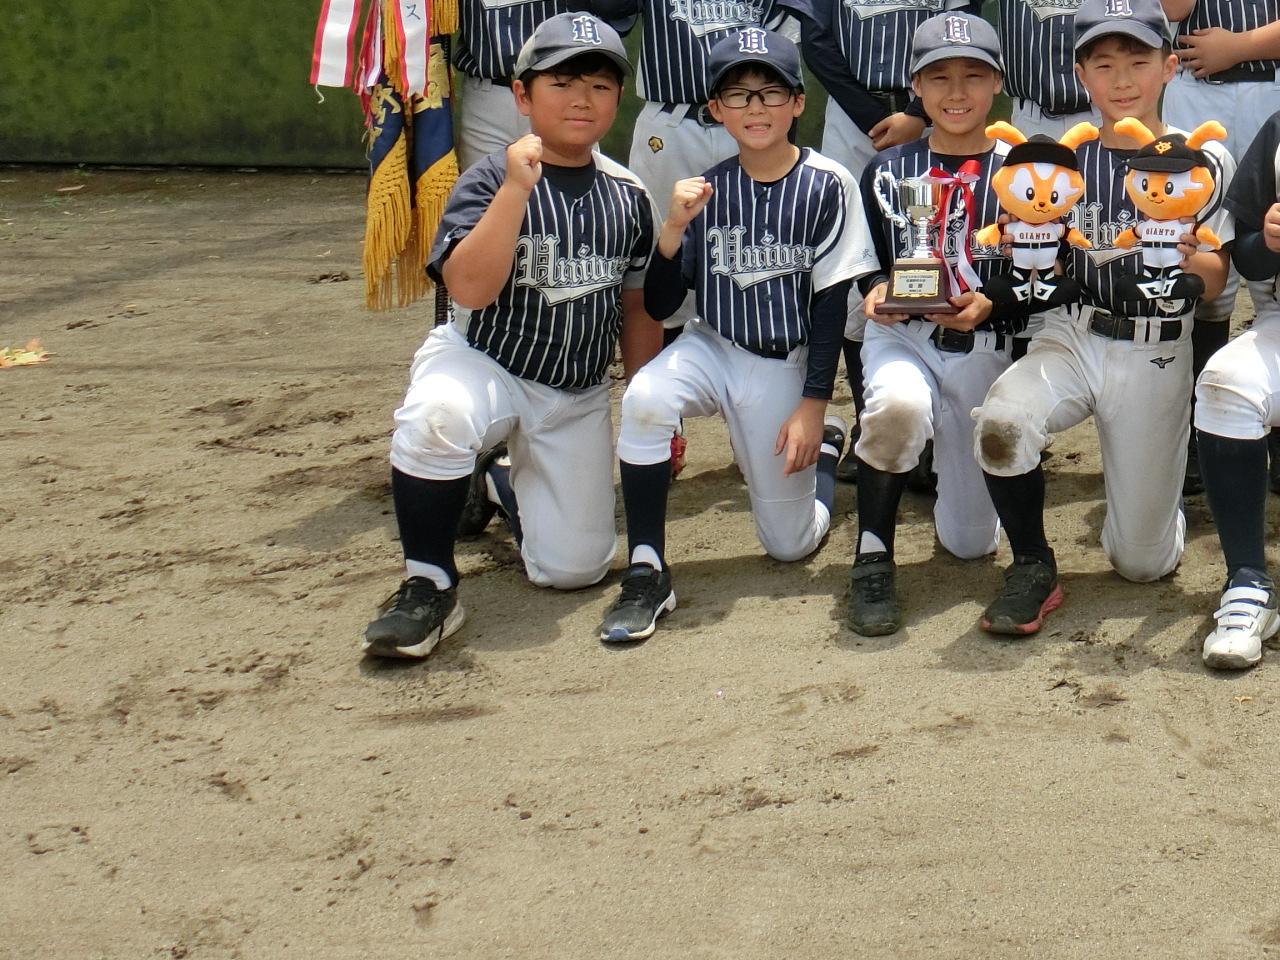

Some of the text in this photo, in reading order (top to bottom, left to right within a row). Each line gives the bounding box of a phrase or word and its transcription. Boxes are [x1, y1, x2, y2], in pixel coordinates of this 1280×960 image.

[1019, 232, 1051, 240] GIANTS
[1145, 228, 1176, 237] GIANTS
[707, 225, 816, 276] Univer
